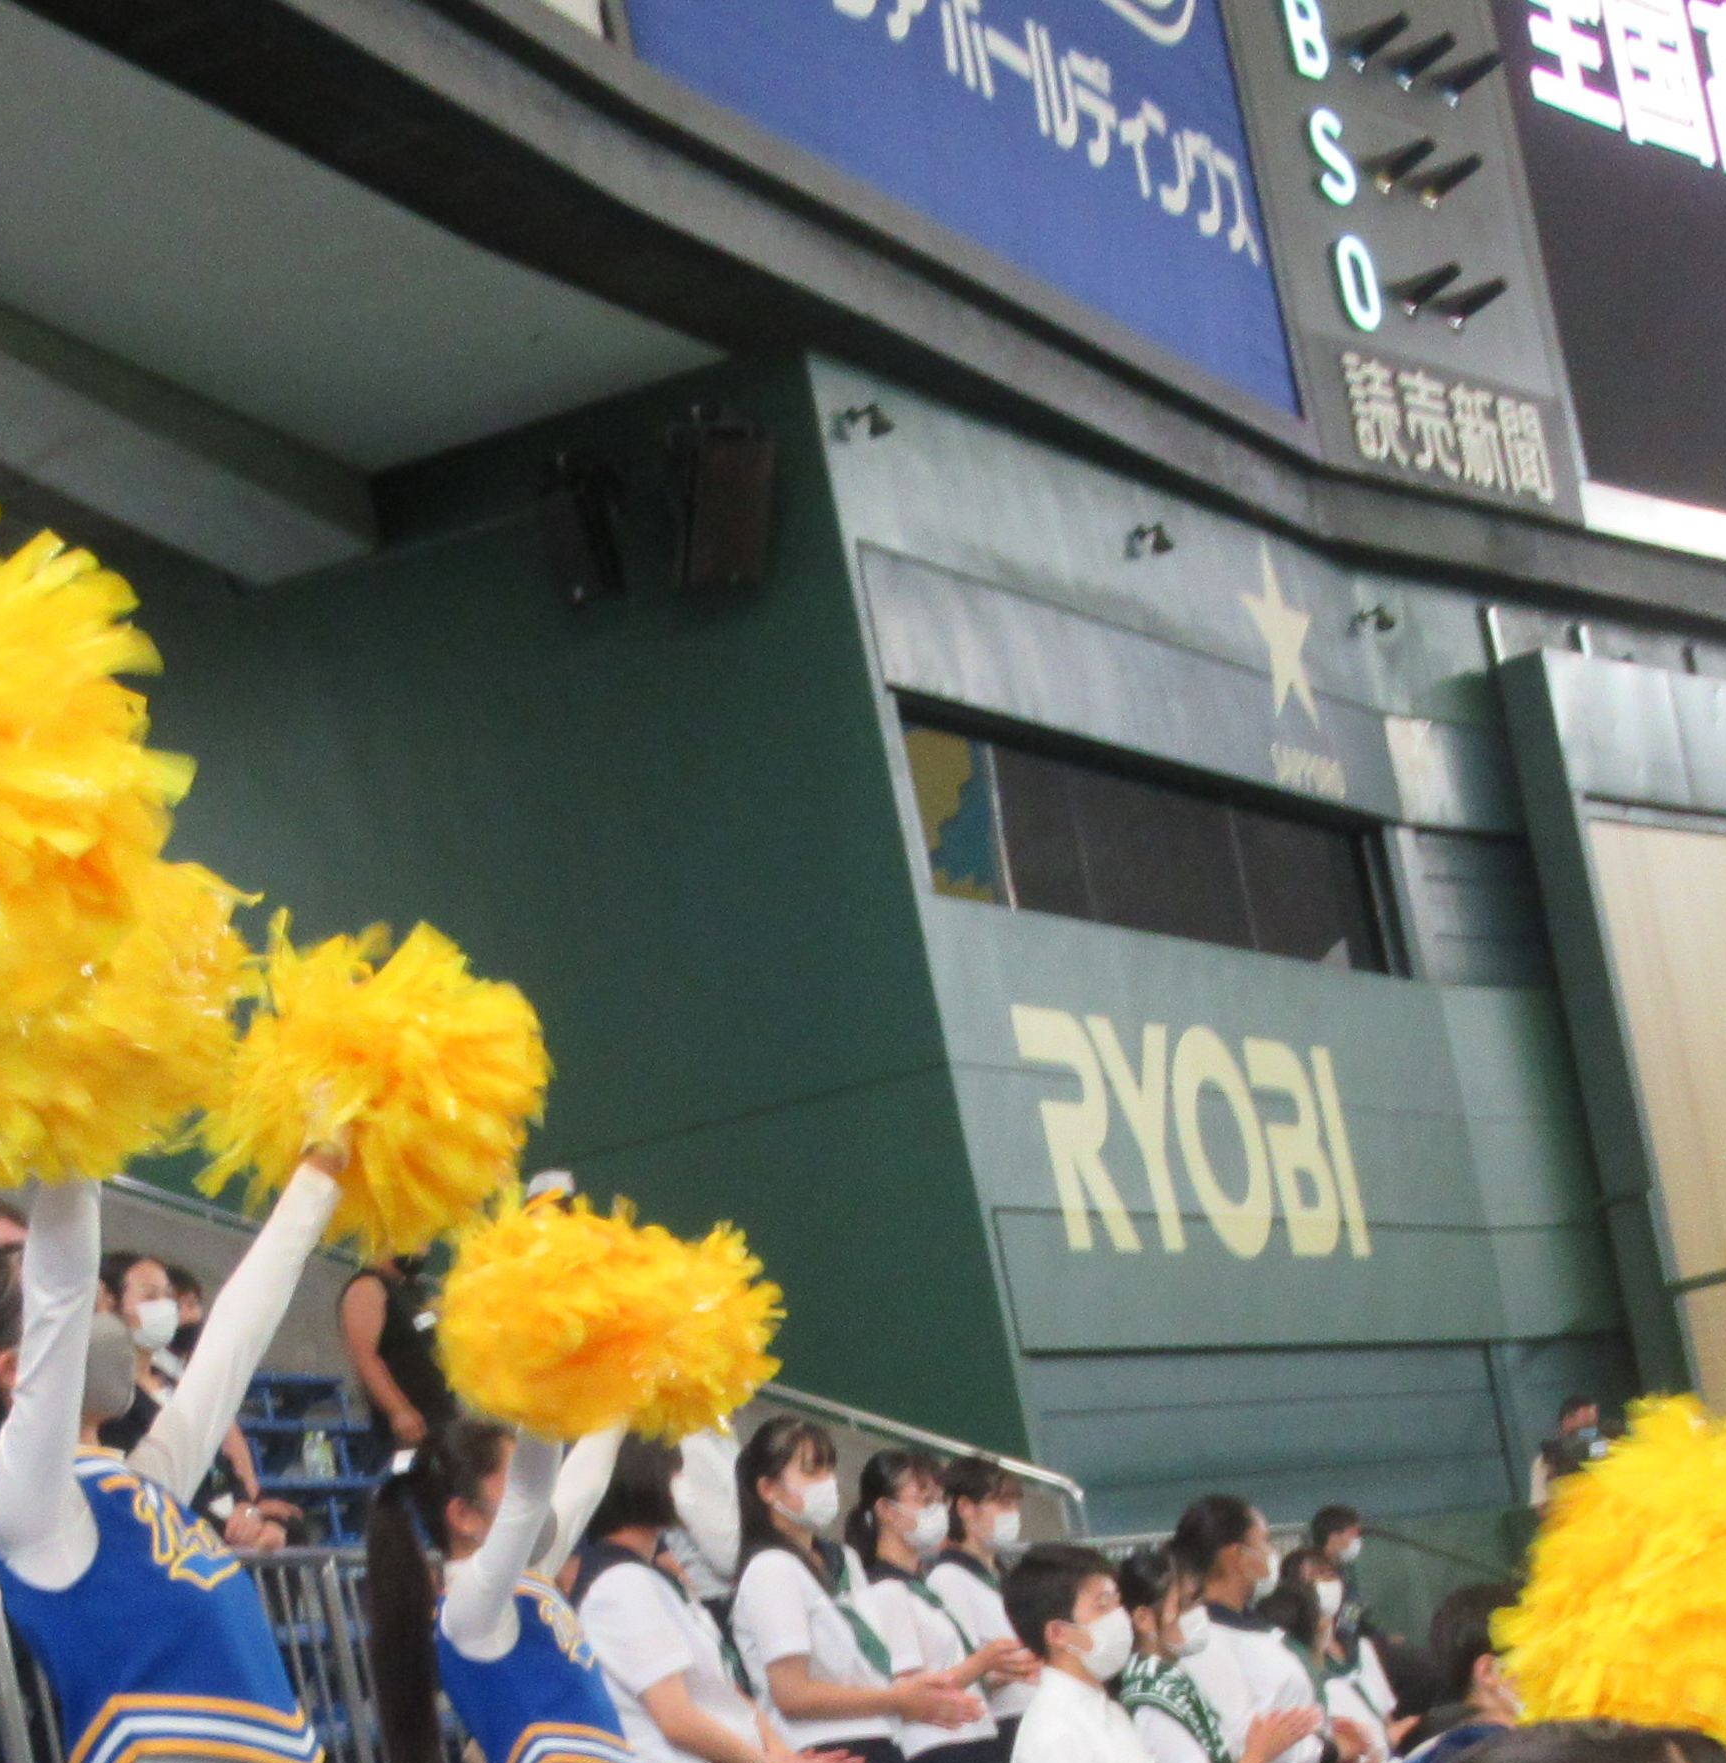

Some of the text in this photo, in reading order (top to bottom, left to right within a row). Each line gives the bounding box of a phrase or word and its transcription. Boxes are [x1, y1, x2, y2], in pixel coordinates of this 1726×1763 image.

[1281, 0, 1330, 80] B
[1309, 107, 1357, 206] S
[1341, 351, 1554, 505] 読売新聞
[1010, 1003, 1373, 1262] RYOBI
